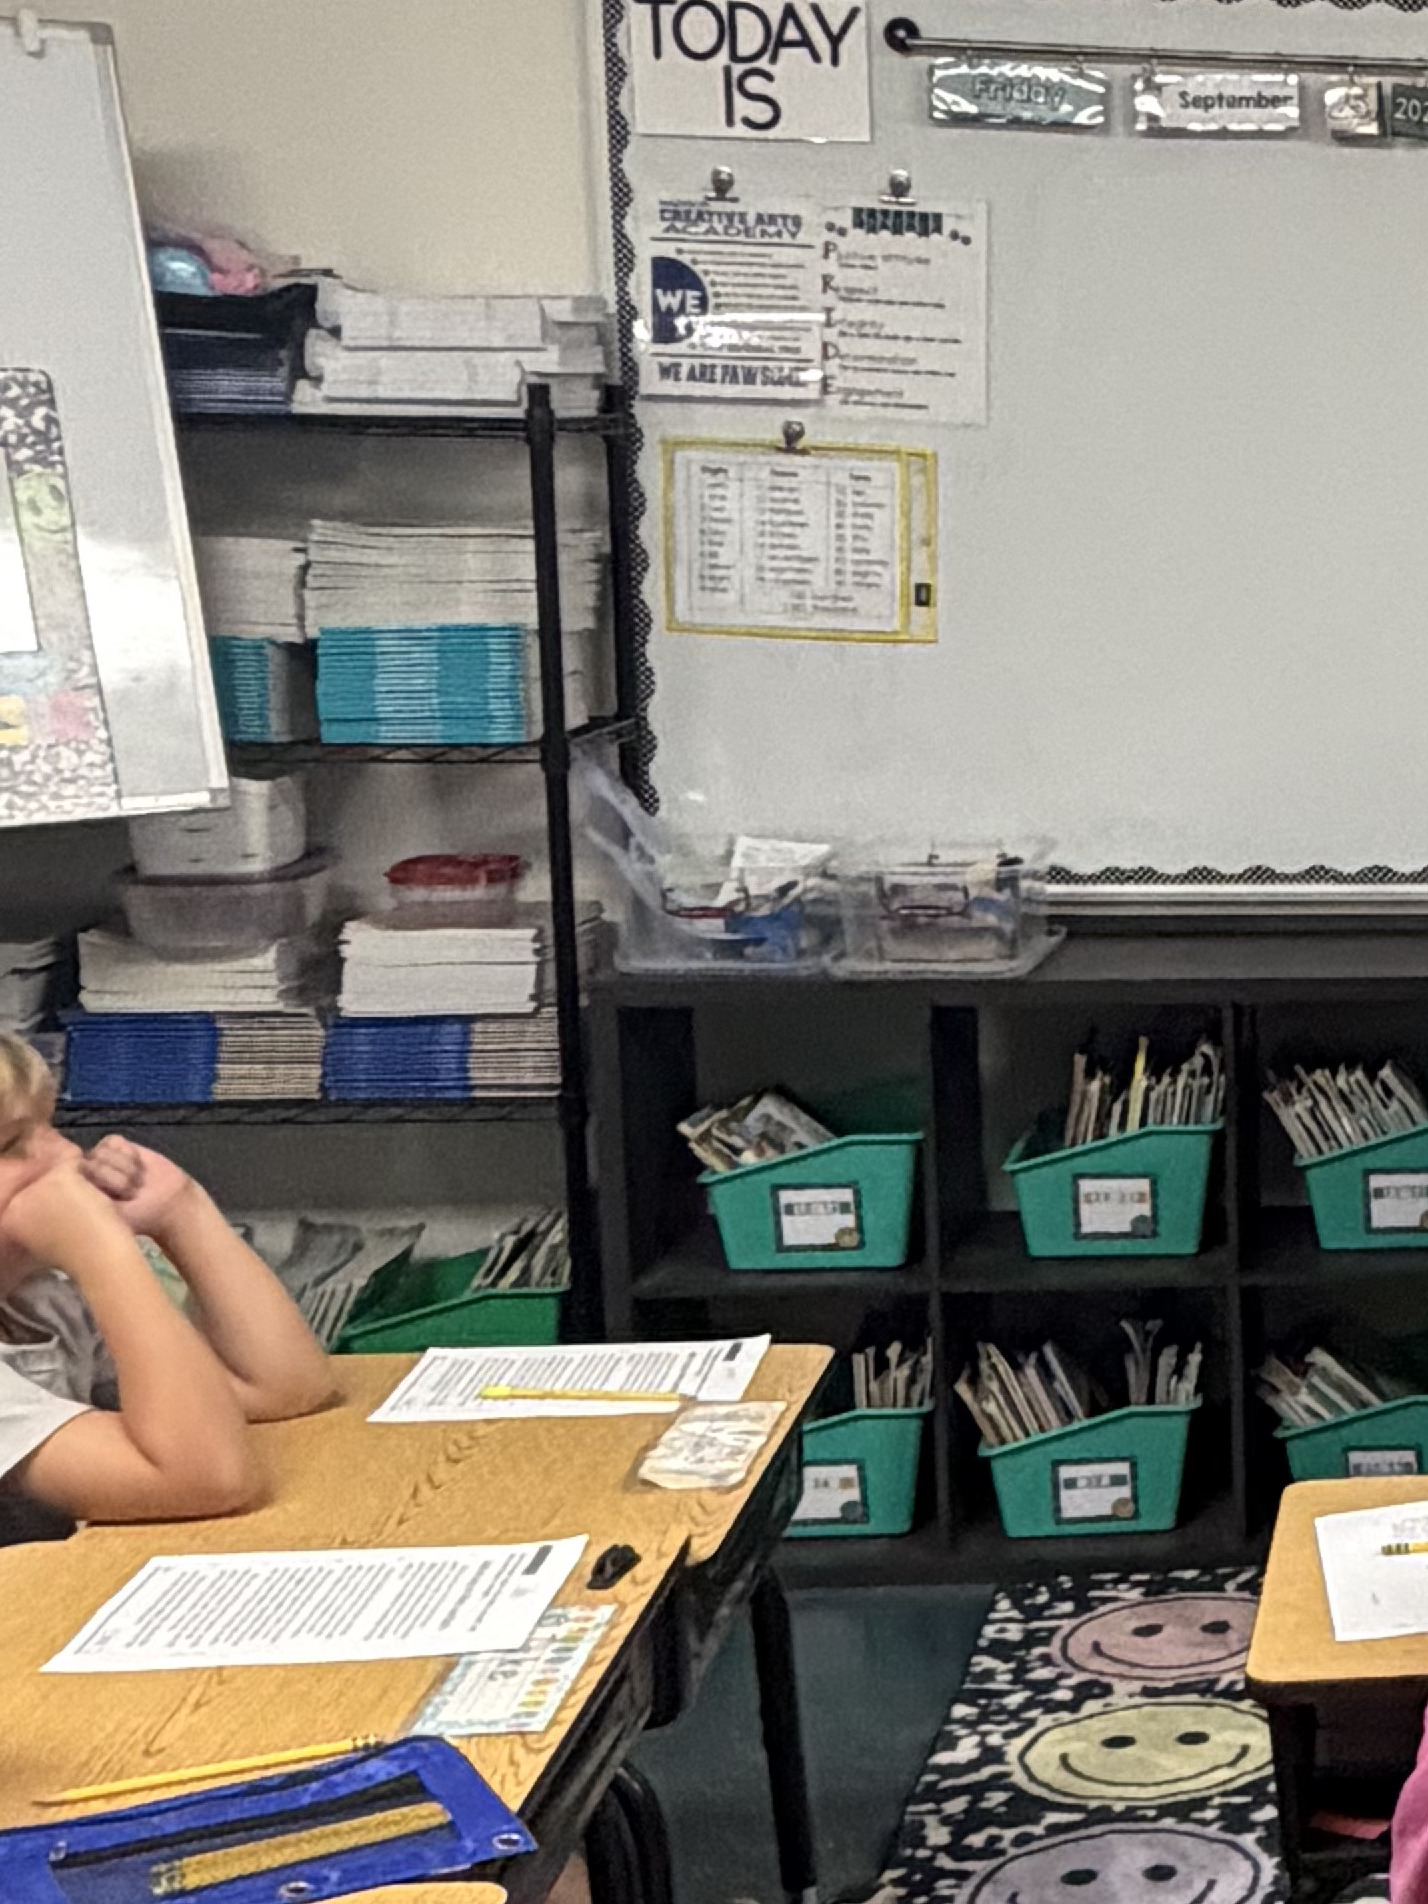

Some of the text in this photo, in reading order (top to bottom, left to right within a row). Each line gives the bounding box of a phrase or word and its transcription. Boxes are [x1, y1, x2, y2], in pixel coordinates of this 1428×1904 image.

[722, 64, 782, 131] IS
[973, 76, 1066, 112] Friday
[1177, 90, 1295, 113] September
[655, 288, 703, 314] WE
[657, 361, 682, 383] WE
